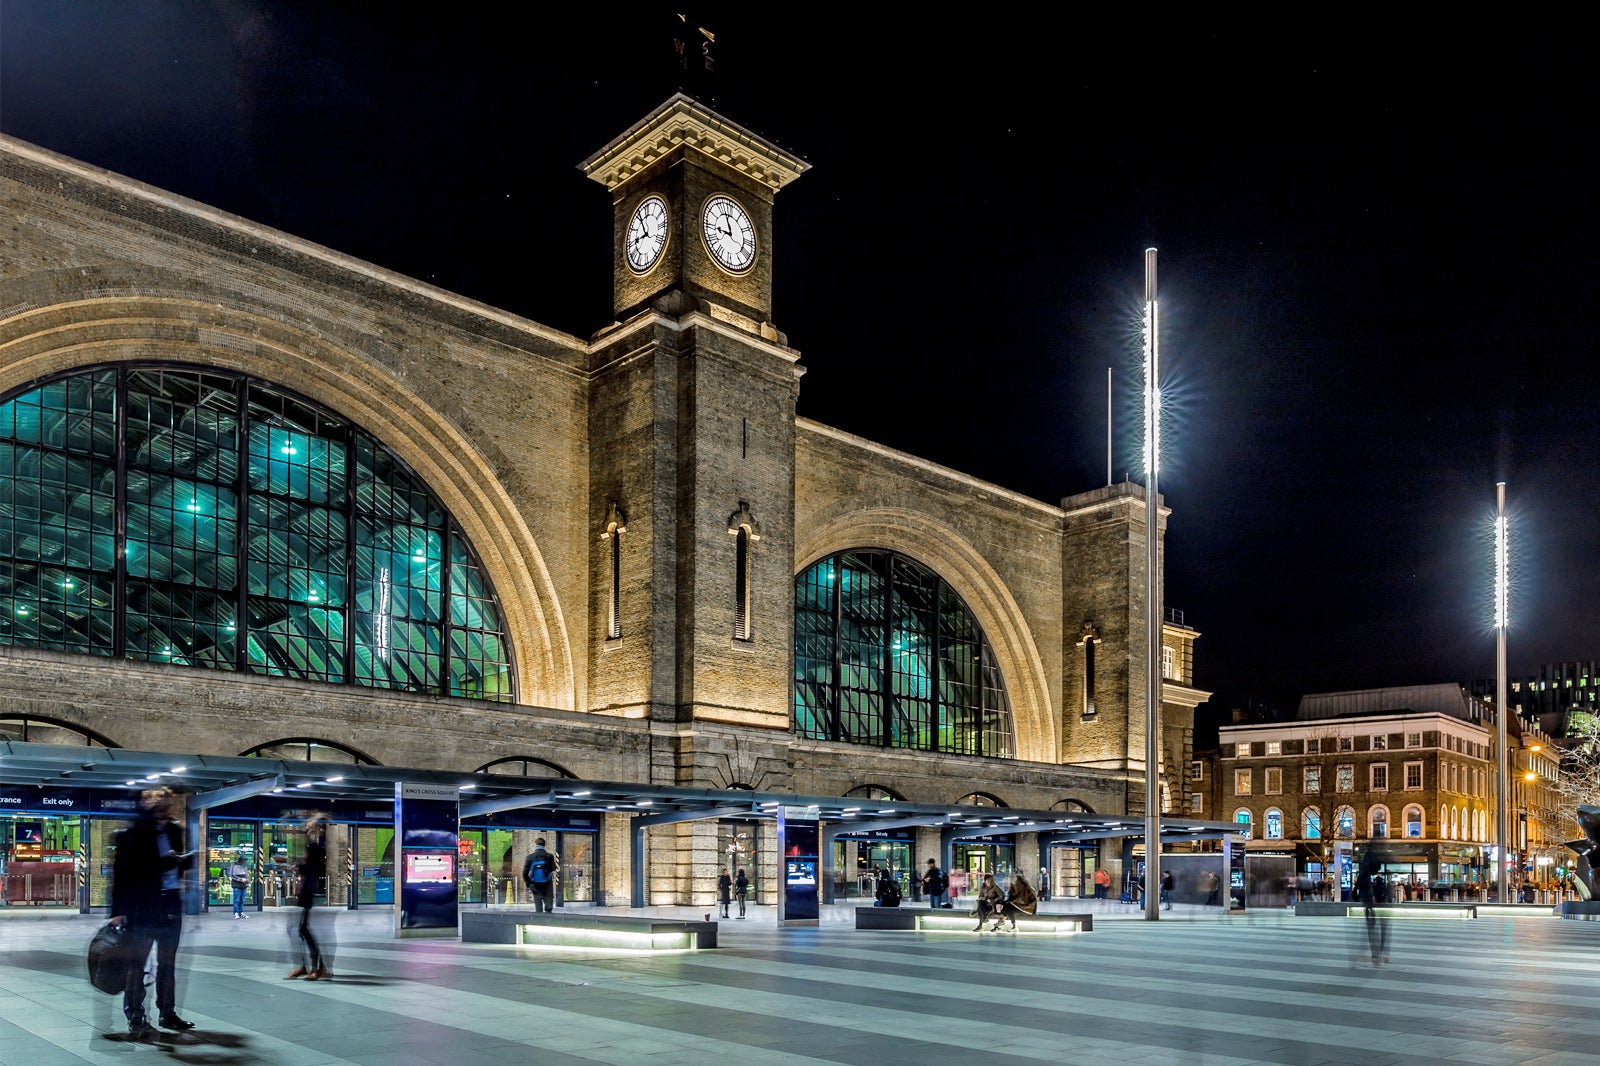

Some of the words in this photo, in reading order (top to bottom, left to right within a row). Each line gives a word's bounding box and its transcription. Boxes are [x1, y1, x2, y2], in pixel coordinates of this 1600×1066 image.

[43, 797, 57, 805] Exit
[58, 798, 74, 807] only
[25, 830, 32, 839] 7
[217, 835, 224, 843] 6
